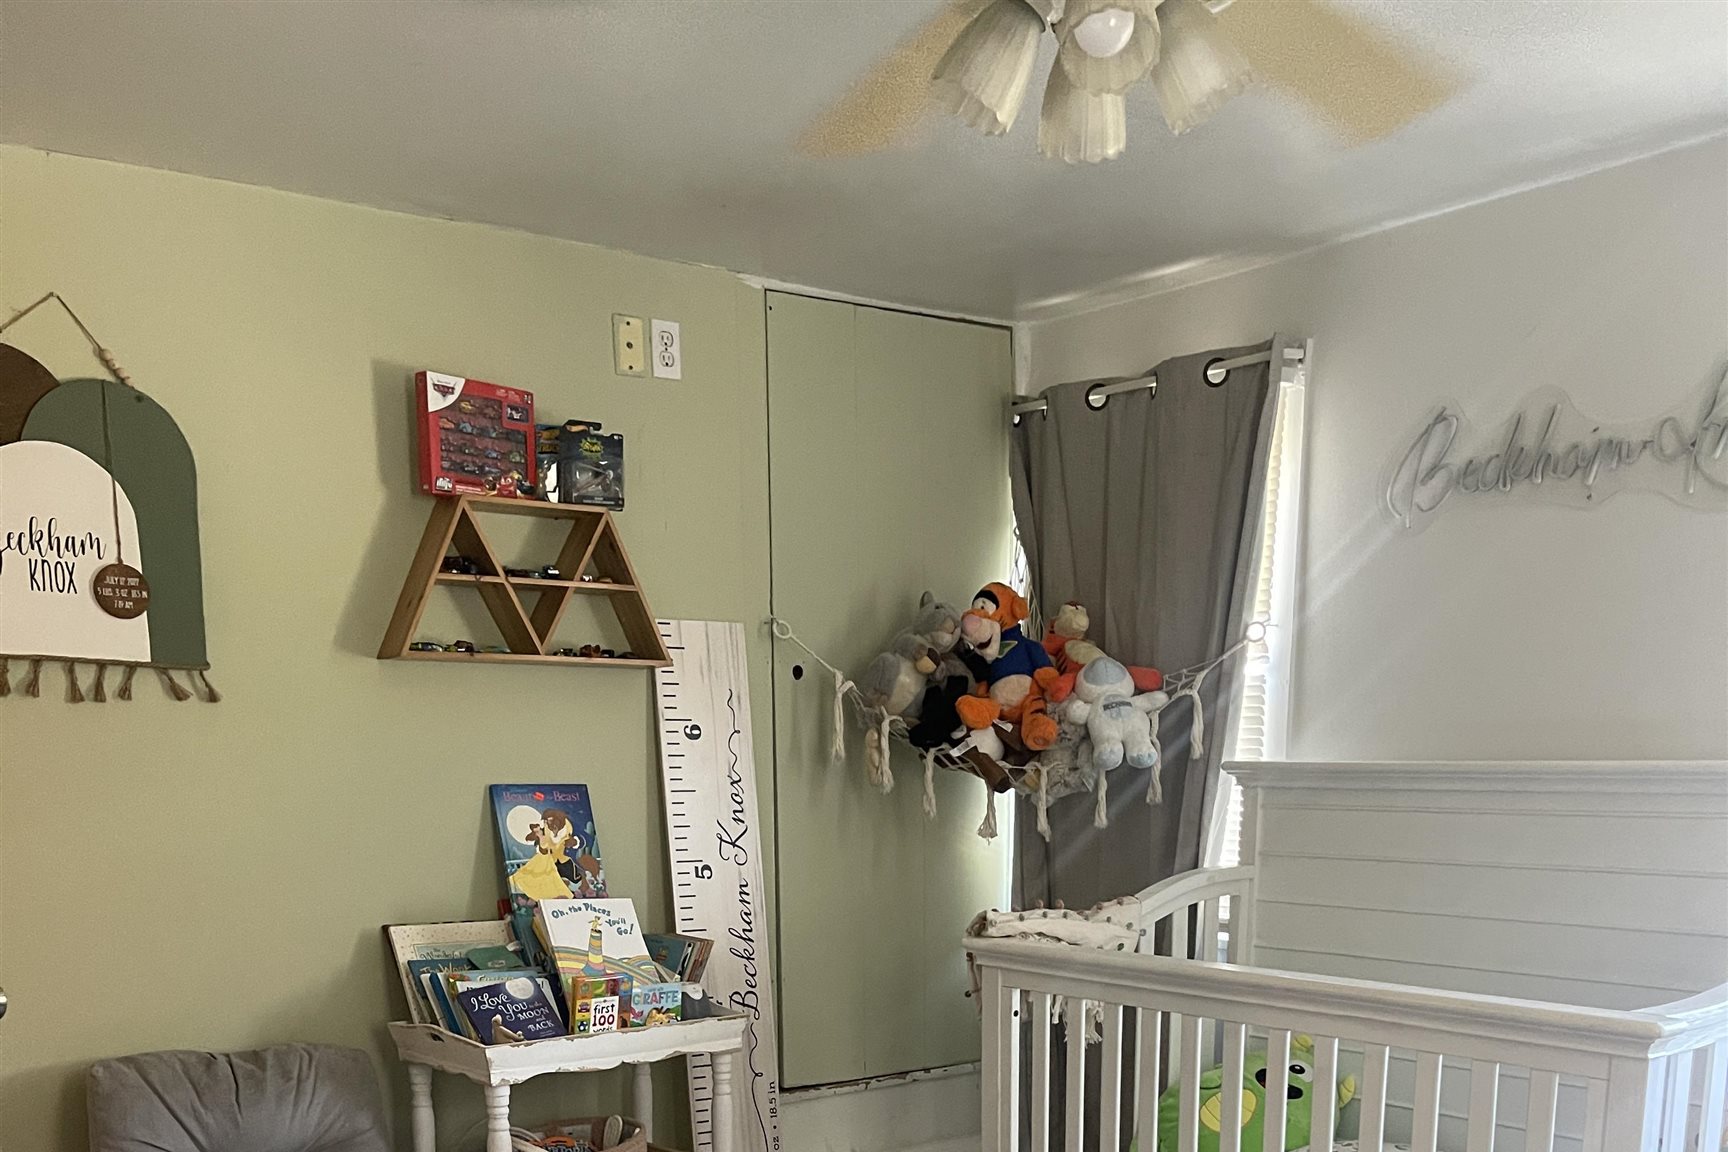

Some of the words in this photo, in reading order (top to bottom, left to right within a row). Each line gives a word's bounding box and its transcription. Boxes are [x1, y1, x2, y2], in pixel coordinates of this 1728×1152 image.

[0, 516, 107, 562] eckham
[684, 724, 702, 741] 6
[716, 774, 748, 866] Knox
[694, 864, 713, 880] 5
[551, 909, 568, 919] Oh,
[568, 905, 582, 914] the
[583, 902, 611, 917] Places
[616, 923, 634, 936] Go!
[728, 877, 760, 1021] Beckham
[471, 995, 480, 1012] I
[479, 992, 511, 1010] Love
[633, 990, 679, 1005] GIRAFFE
[499, 1001, 528, 1021] You
[517, 1006, 550, 1021] MOON
[593, 1004, 615, 1015] first
[527, 1020, 555, 1032] BACK
[592, 1014, 615, 1027] 100
[767, 1081, 776, 1094] in
[769, 1097, 778, 1119] 18.5
[772, 1135, 780, 1151] oz
